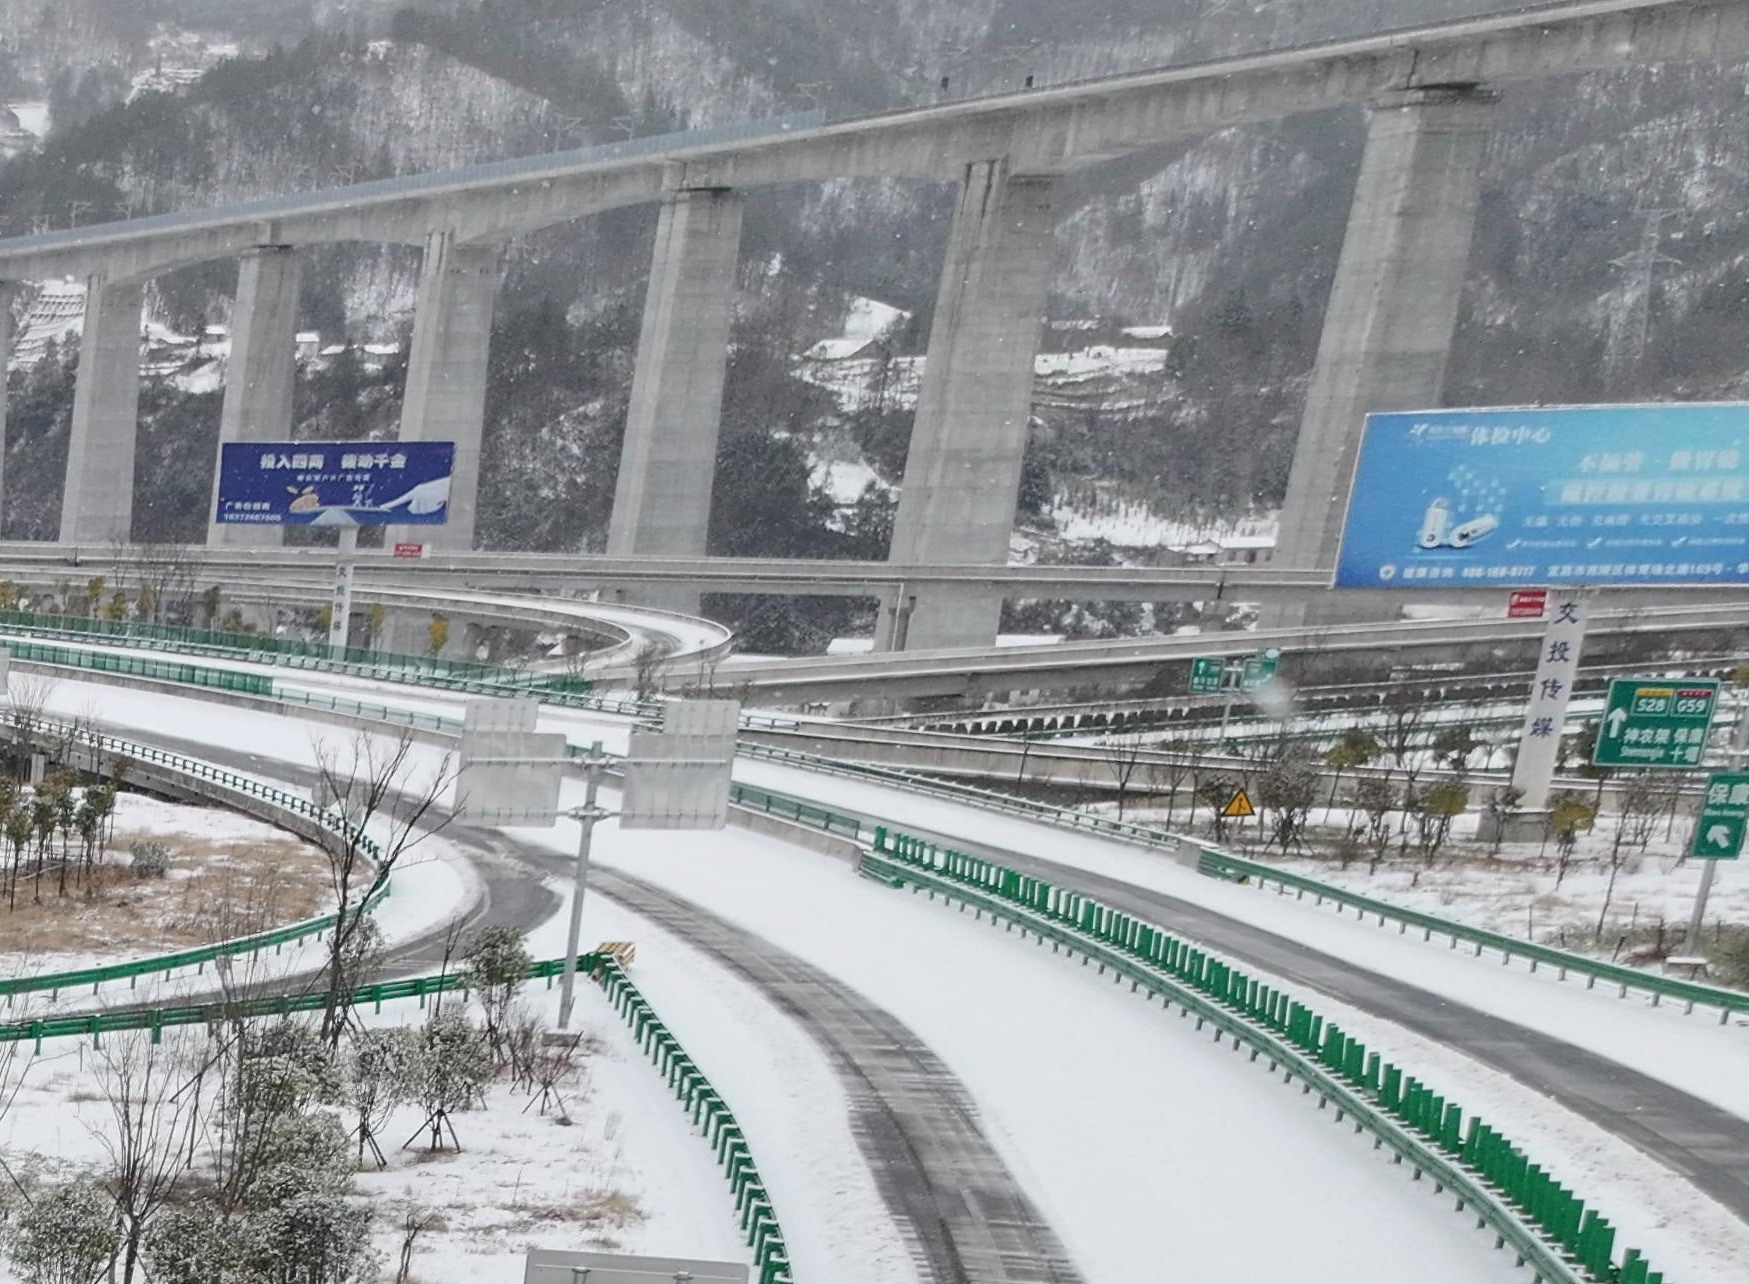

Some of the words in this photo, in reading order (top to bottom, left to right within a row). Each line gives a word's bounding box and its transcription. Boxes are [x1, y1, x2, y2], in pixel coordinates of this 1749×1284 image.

[1470, 426, 1551, 446] 体检中心
[261, 454, 324, 470] 投入四两
[1529, 601, 1578, 738] 交投传媒
[1637, 699, 1667, 712] S28
[1677, 700, 1707, 713] G59
[1623, 727, 1671, 744] 神农架
